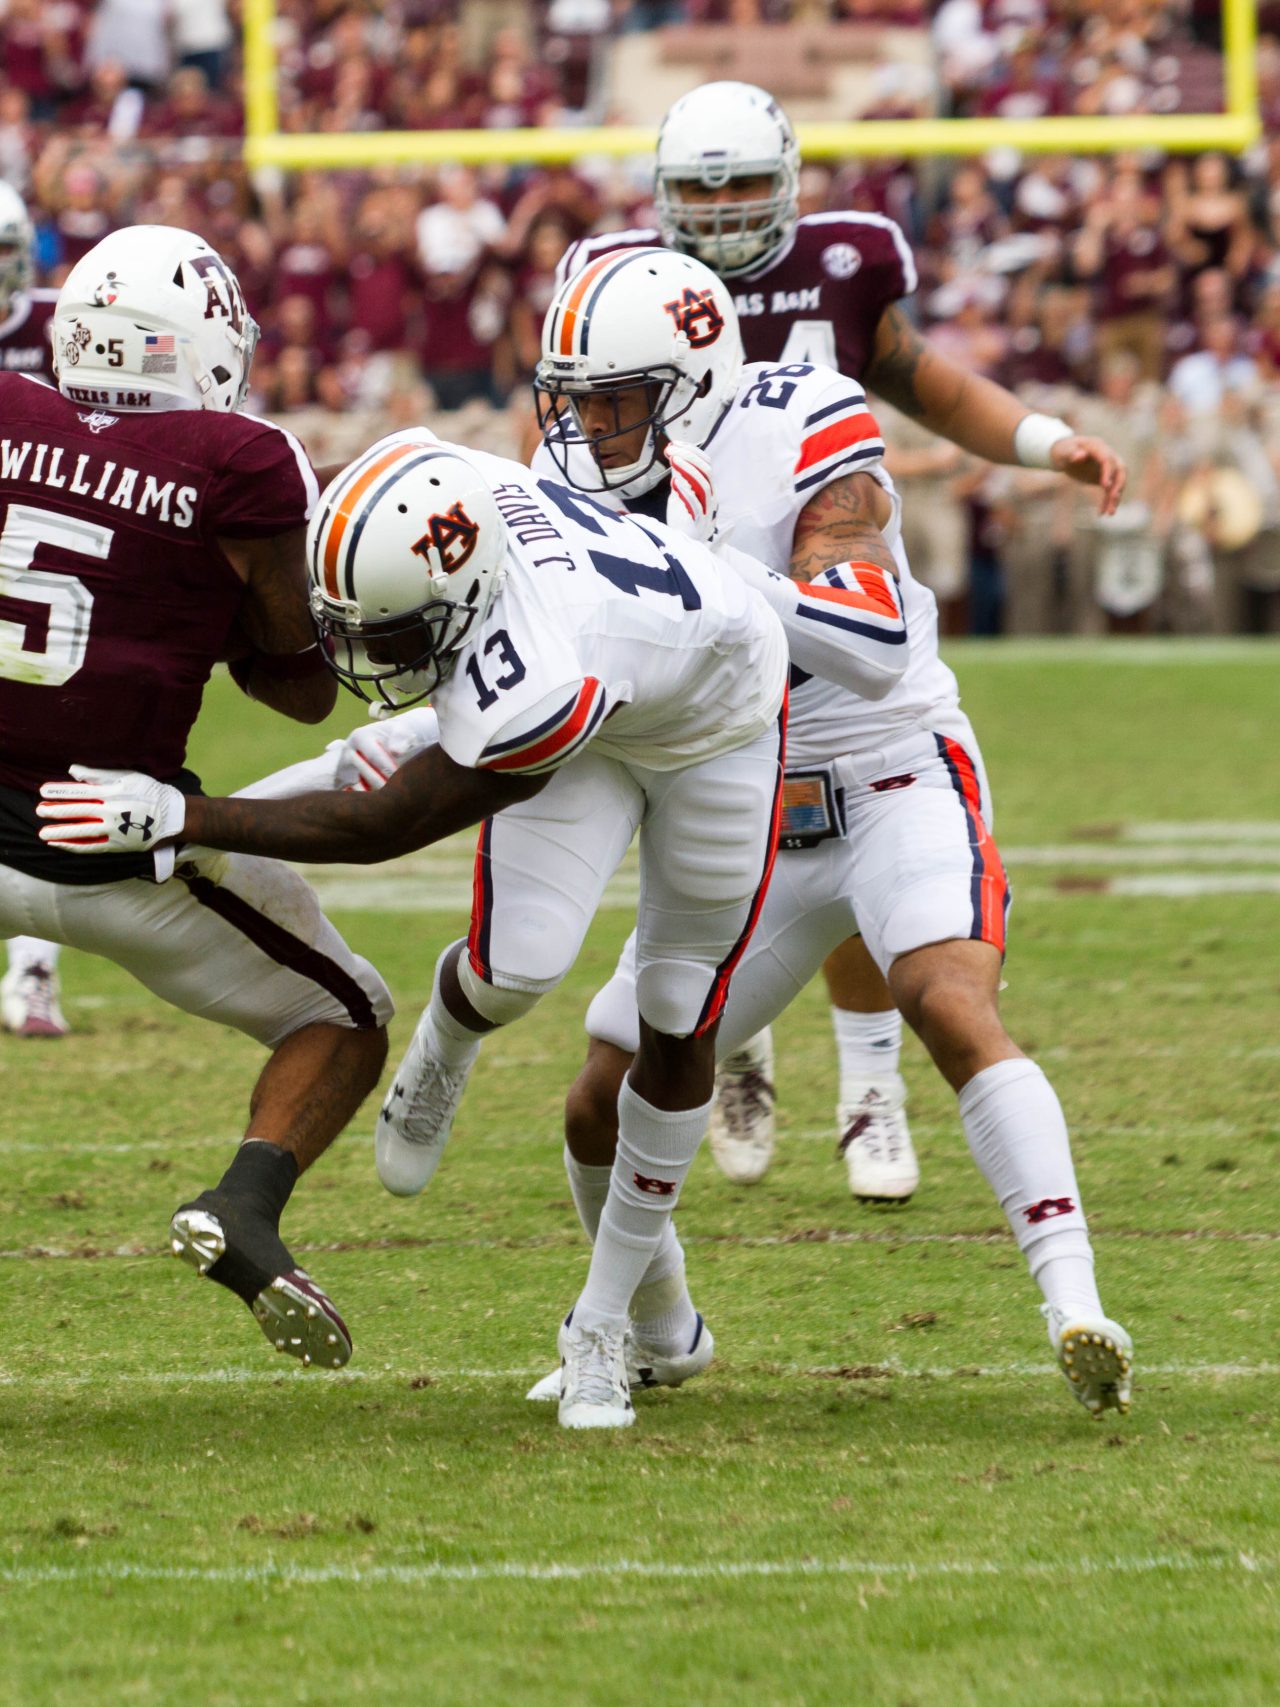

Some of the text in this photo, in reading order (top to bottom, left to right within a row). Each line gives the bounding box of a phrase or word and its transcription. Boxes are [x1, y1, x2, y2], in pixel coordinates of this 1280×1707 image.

[107, 338, 125, 367] 5
[66, 386, 110, 405] TEXAS
[116, 392, 152, 408] A&M
[0, 439, 197, 529] WILLIAMS
[492, 483, 564, 547] DAVIS
[465, 628, 527, 713] 13
